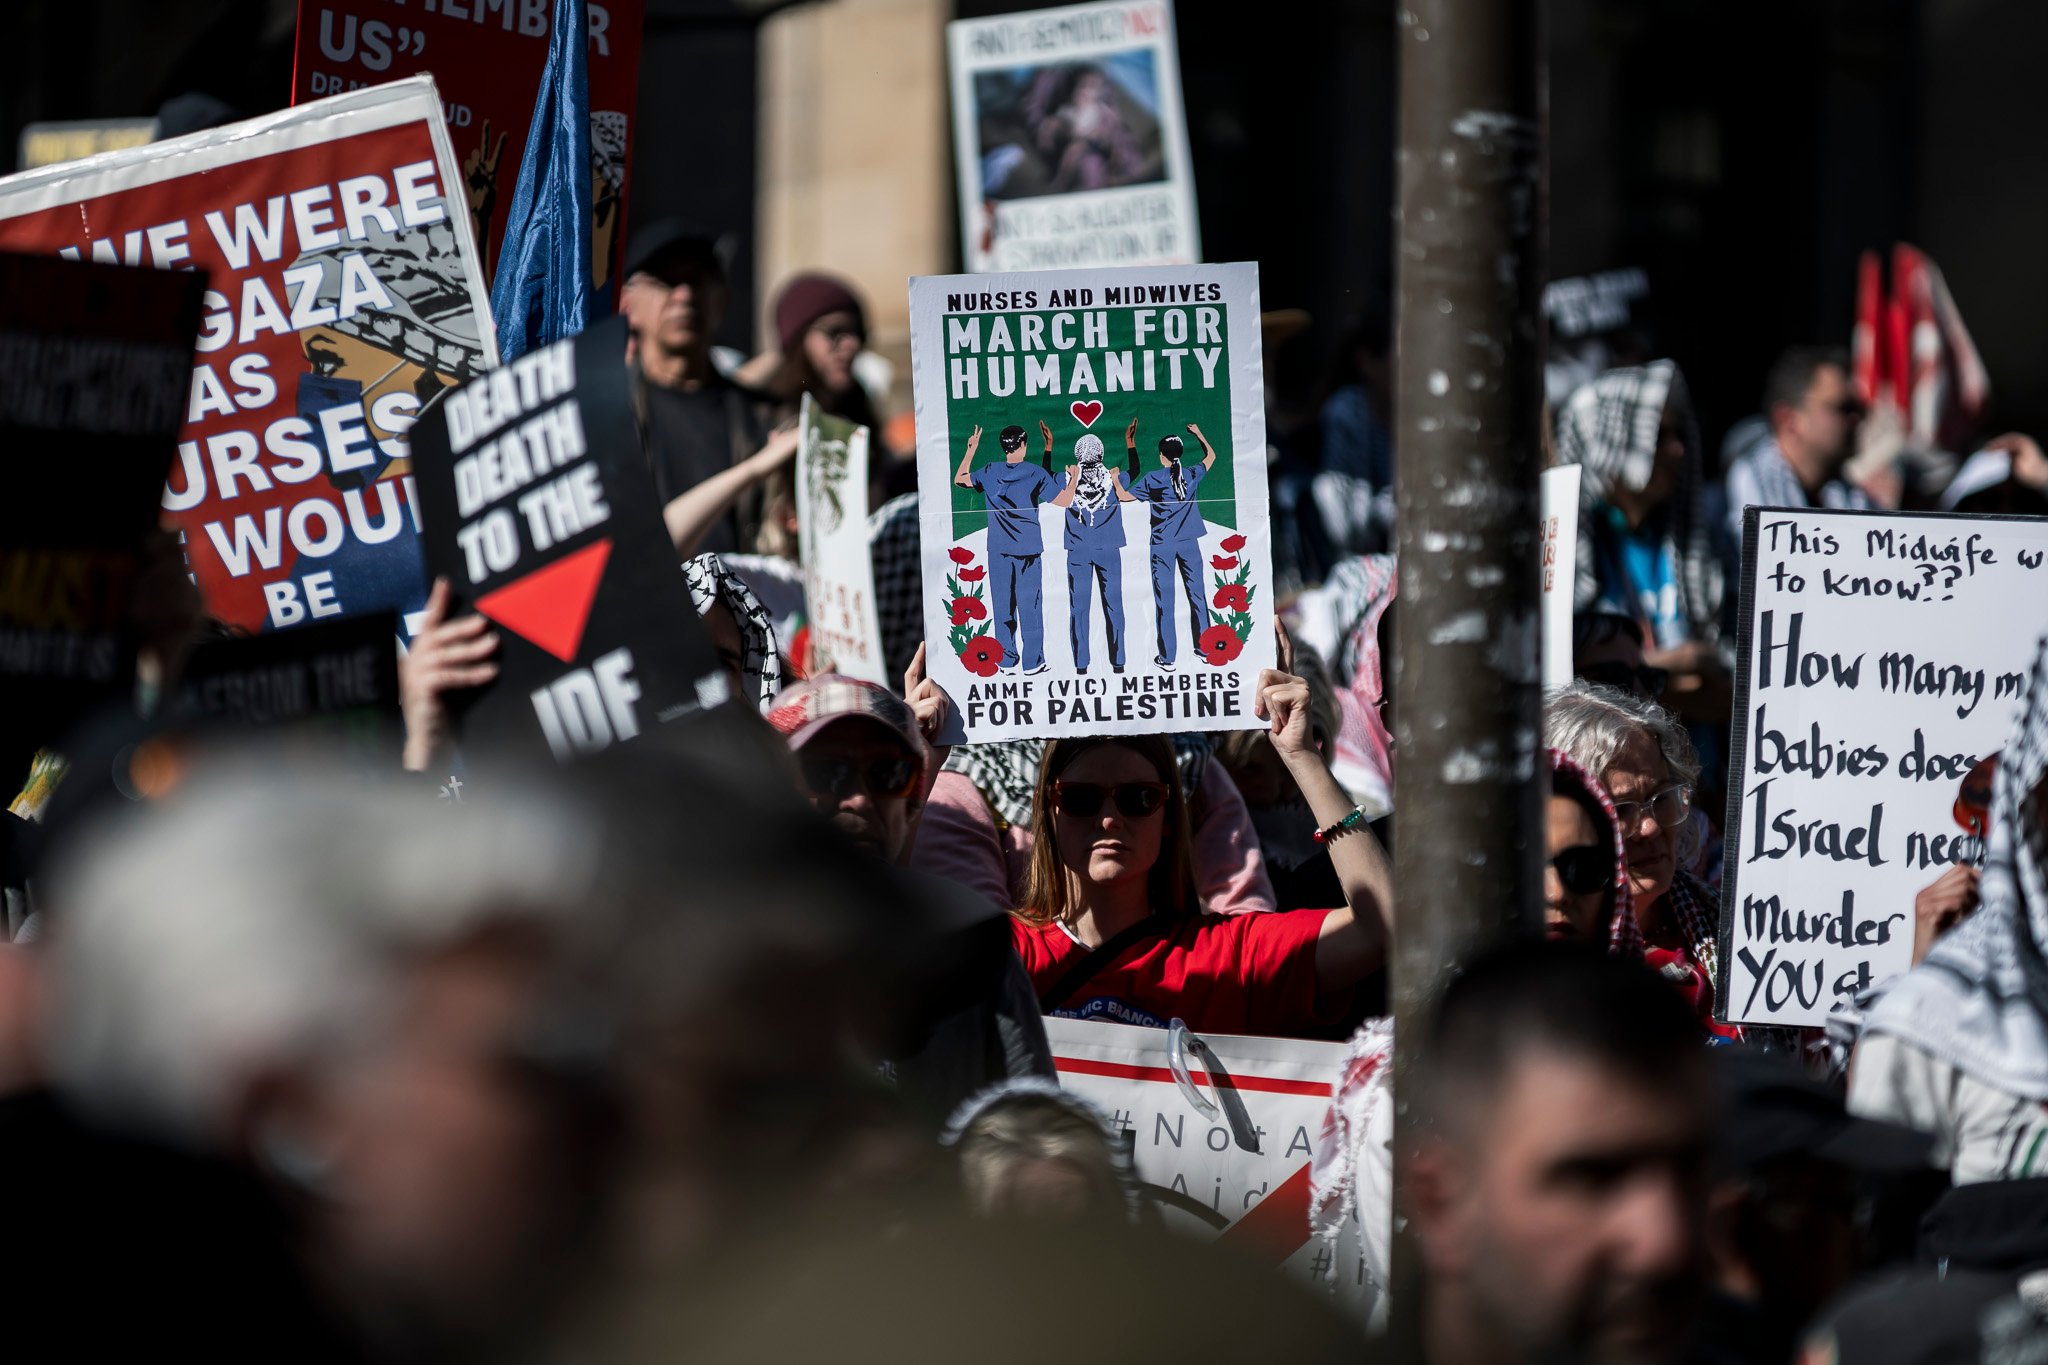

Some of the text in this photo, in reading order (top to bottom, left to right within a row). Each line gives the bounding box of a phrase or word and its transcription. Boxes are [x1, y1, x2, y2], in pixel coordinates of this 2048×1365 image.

[204, 160, 448, 270] WERE
[195, 252, 394, 352] GAZA
[947, 283, 1221, 312] NURSES AND MIDWIVES
[948, 307, 1222, 354] MARCH FOR
[187, 353, 277, 422] AS
[444, 338, 577, 454] DEATH
[950, 347, 1222, 399] HUMANITY
[160, 392, 421, 511] URSES
[453, 397, 587, 519] DEATH
[456, 460, 611, 586] TO THE
[1763, 521, 2048, 576] This Midwife w
[263, 570, 342, 629] BE
[1767, 561, 1962, 602] to know??
[968, 671, 1240, 701] ANMF (VIC) MEMBERS
[1759, 610, 1866, 690] How
[1879, 652, 1985, 719] many
[530, 645, 642, 767] IDF
[968, 690, 1241, 728] FOR PALESTINE
[1754, 703, 1889, 779] babies
[1746, 777, 1976, 870] Israel nee
[1082, 1000, 1102, 1017] VIC
[1737, 946, 1824, 1020] YOU
